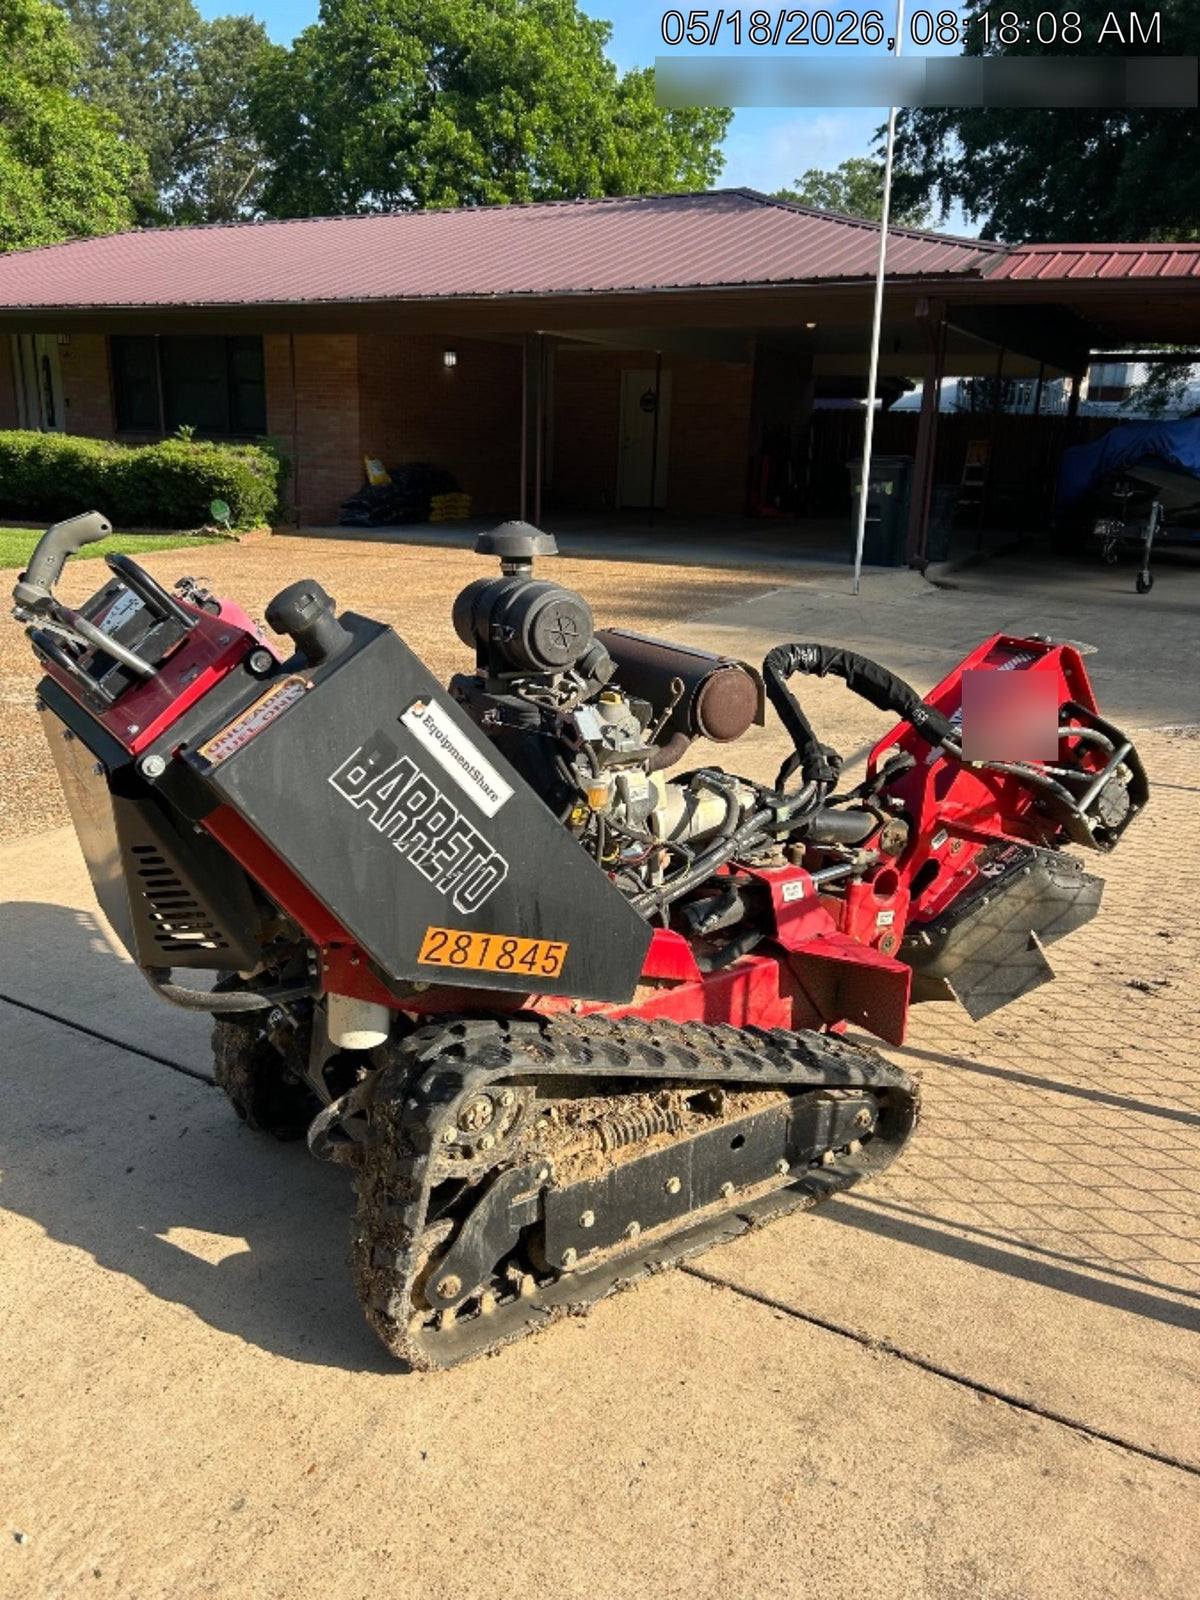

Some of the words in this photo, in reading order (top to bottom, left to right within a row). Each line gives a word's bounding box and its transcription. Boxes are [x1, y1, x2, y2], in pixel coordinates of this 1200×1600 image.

[216, 727, 257, 761] FUEL
[262, 685, 304, 721] ONLY
[422, 714, 501, 803] EquipmentShare
[328, 746, 510, 915] BARRETO
[423, 930, 564, 975] 281845
